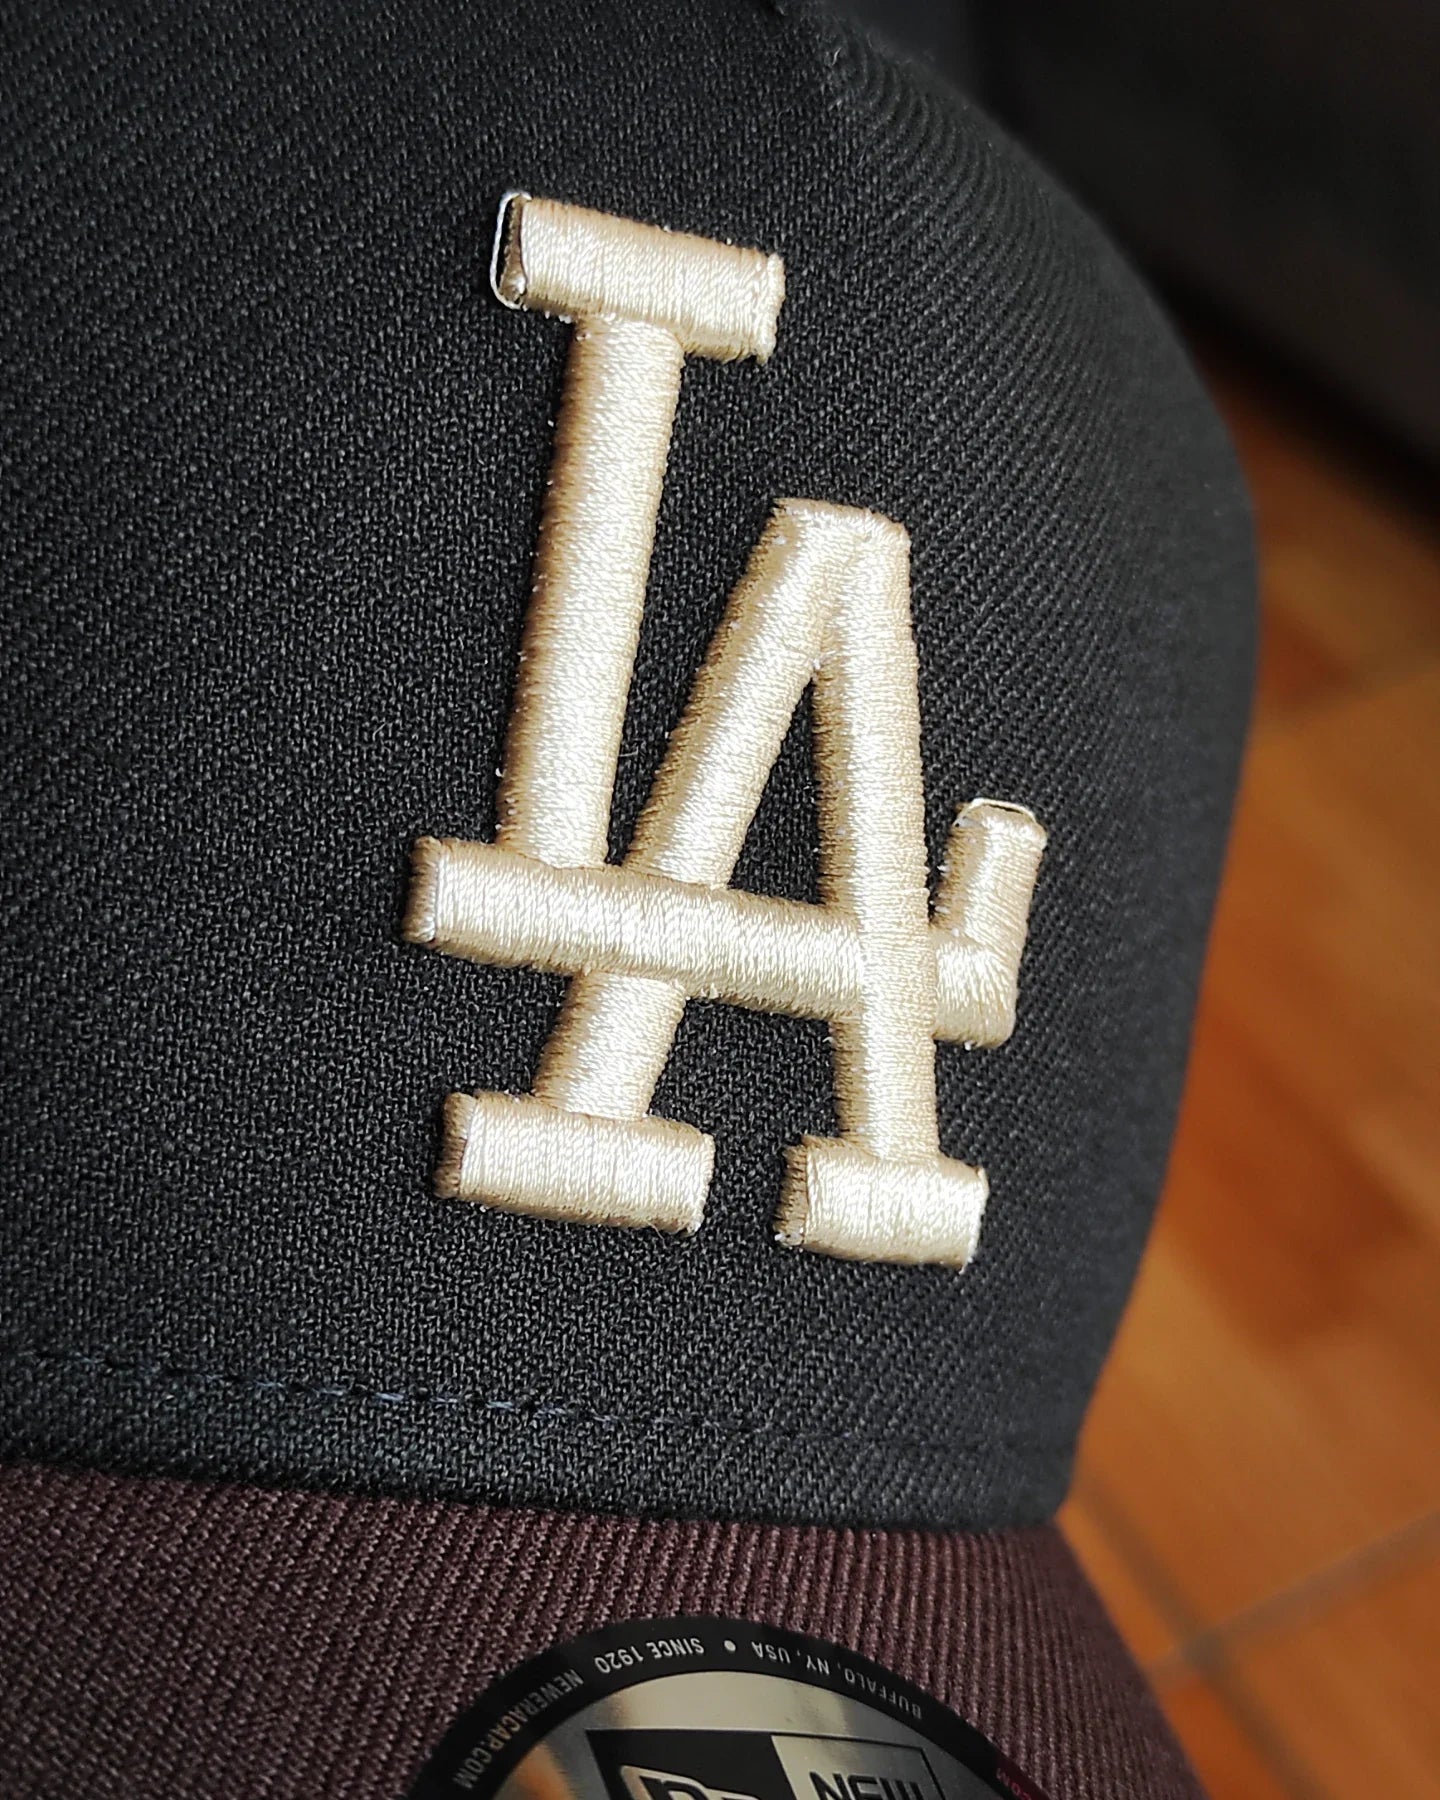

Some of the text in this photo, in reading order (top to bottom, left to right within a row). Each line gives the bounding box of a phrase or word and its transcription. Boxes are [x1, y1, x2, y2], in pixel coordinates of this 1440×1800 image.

[405, 193, 1048, 1274] LA
[593, 1645, 644, 1674] 1920
[645, 1637, 705, 1660] SINCE
[750, 1640, 792, 1665] USA
[451, 1668, 585, 1790] NEWERACAP.COM
